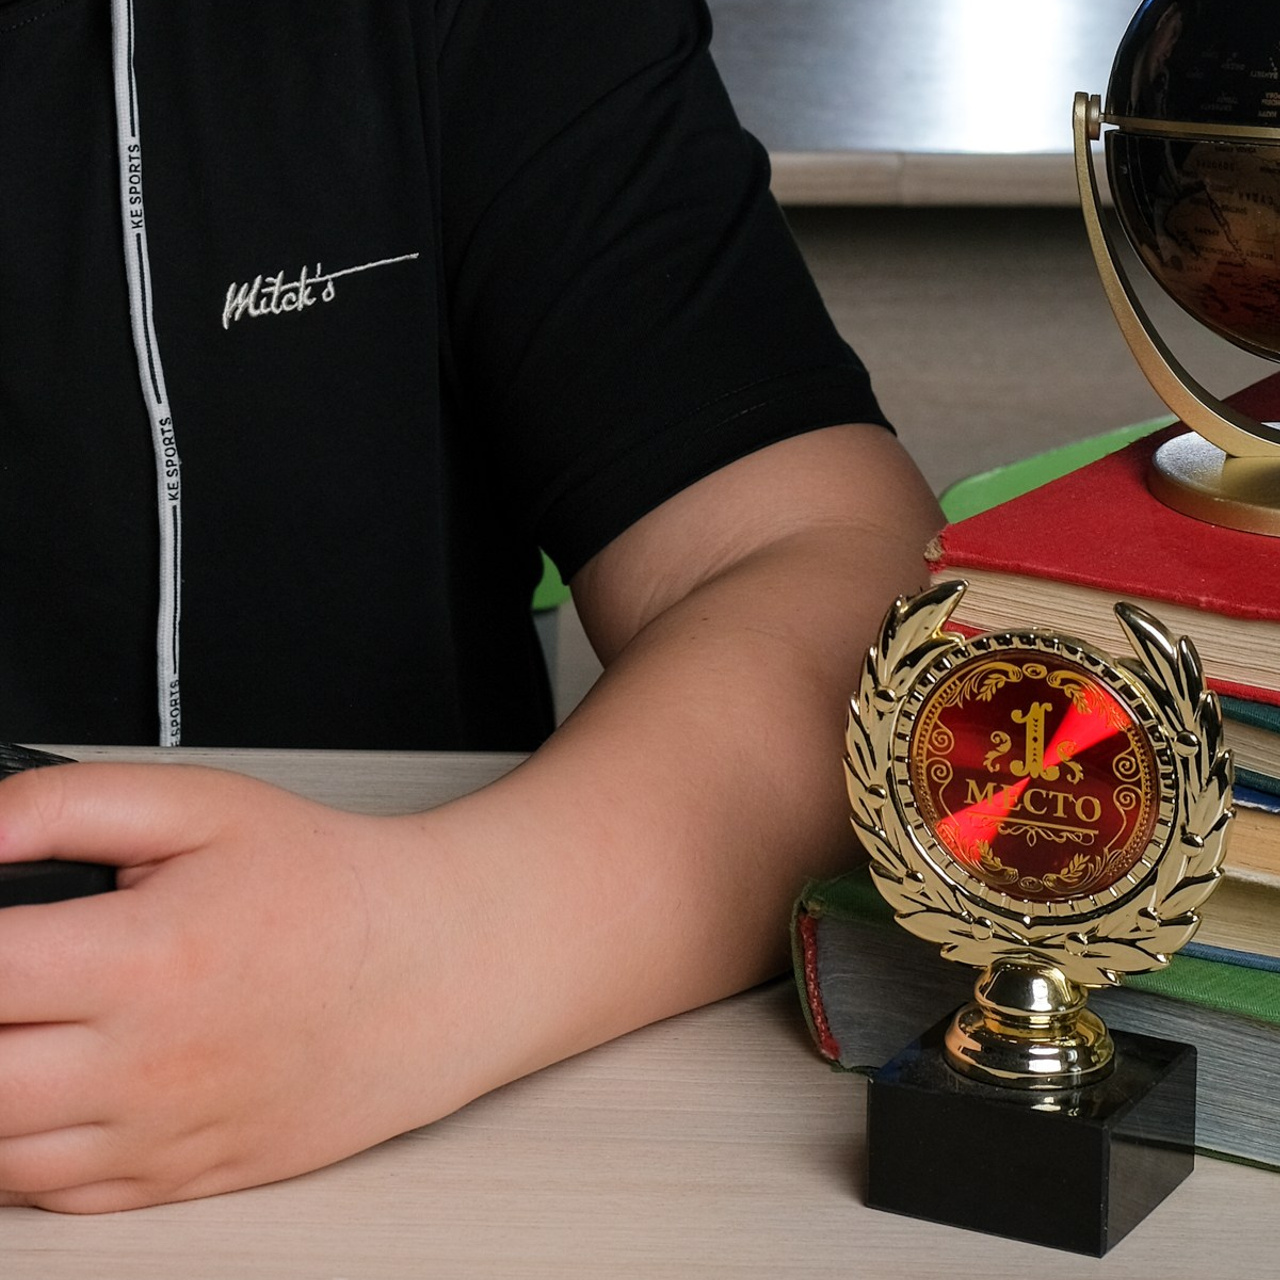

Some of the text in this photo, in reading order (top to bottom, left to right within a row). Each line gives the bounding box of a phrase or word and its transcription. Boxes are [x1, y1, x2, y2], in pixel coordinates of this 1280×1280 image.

[128, 144, 143, 229] KE SPORTS
[159, 417, 180, 501] KE SPORTS
[170, 679, 180, 737] SPORTS
[1009, 701, 1060, 781] 1
[964, 778, 1102, 823] МЕСТО
